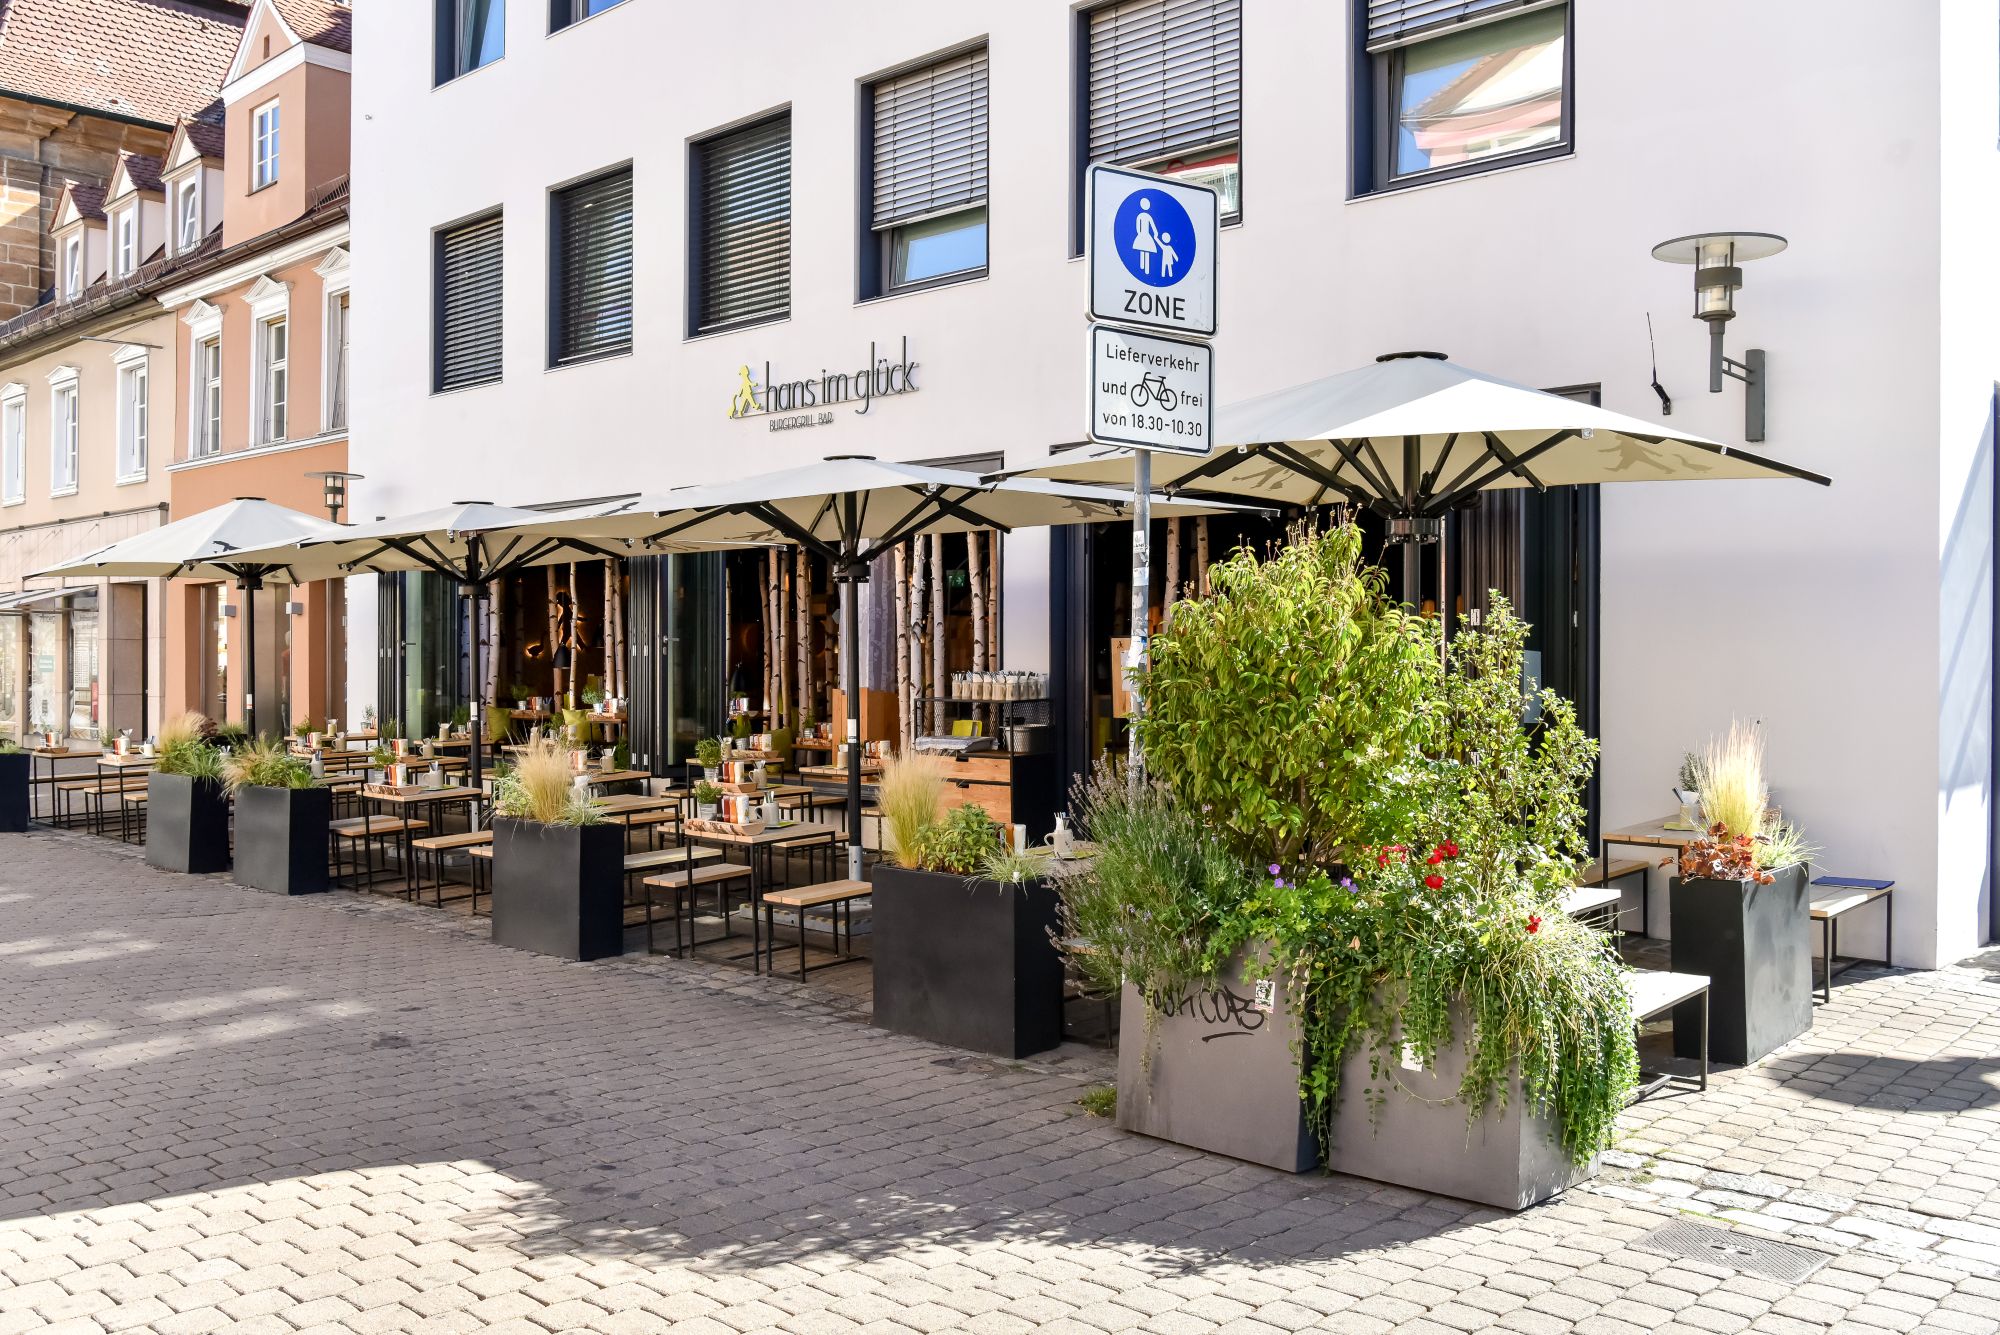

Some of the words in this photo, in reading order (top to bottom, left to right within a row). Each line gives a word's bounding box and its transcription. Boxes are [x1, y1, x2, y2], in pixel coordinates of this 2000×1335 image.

[1124, 289, 1186, 321] ZONE
[1106, 343, 1200, 373] Lieferverkehr
[766, 360, 816, 412] hans
[822, 369, 848, 403] im
[855, 335, 915, 414] glück
[1102, 381, 1127, 396] und
[1181, 390, 1203, 408] frei
[769, 414, 815, 433] BURGERGRILL
[818, 411, 833, 426] BAR
[1103, 412, 1127, 427] von
[1132, 413, 1202, 437] 18.30-10.30
